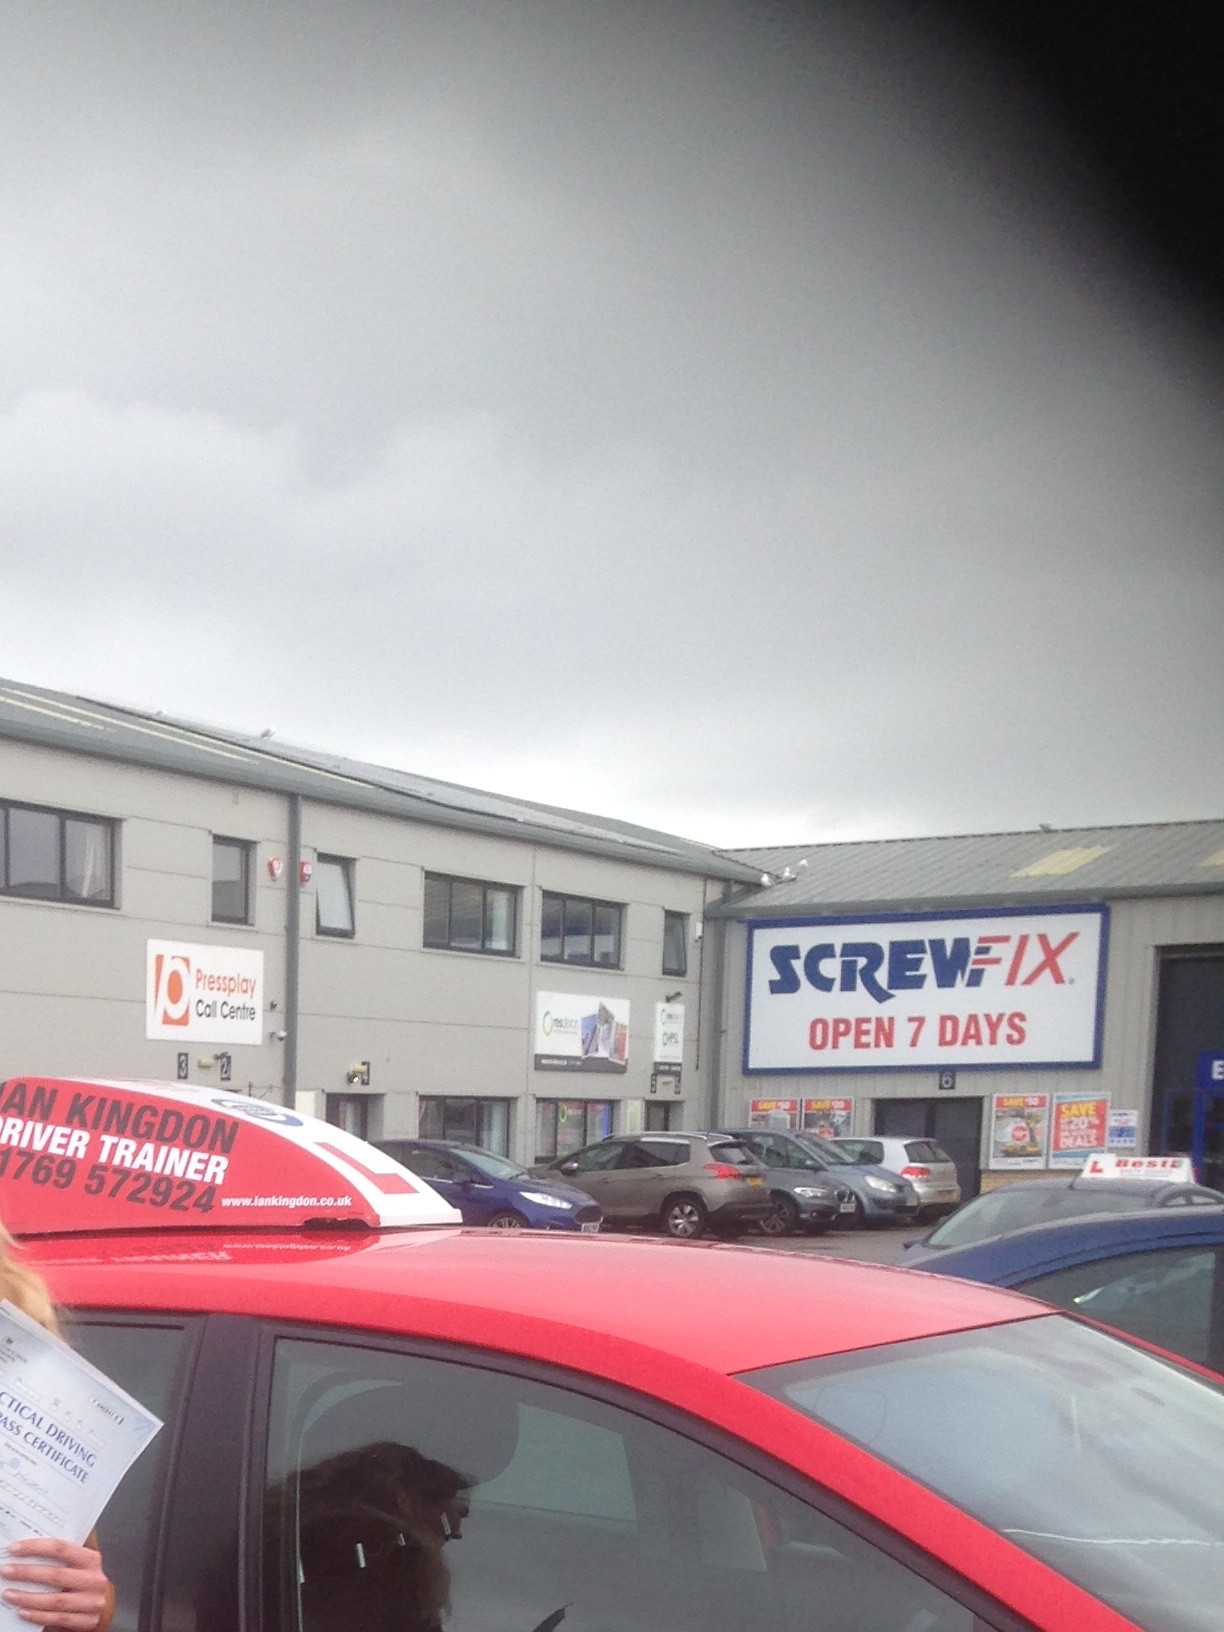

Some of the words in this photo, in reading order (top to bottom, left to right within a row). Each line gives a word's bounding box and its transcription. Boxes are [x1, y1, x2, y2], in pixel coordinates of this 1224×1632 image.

[195, 968, 256, 999] Pressplay
[768, 932, 1080, 1004] SCREWFIX
[195, 999, 218, 1018] Call
[220, 1001, 256, 1021] Centre
[809, 1016, 895, 1050] OPEN
[907, 1016, 926, 1047] 7
[938, 1012, 1027, 1047] DAYS
[178, 1055, 187, 1077] 3
[941, 1074, 954, 1089] 6
[66, 1093, 240, 1153] KINGDON
[1060, 1103, 1097, 1118] SAVE
[99, 1135, 229, 1185] TRAINER
[84, 1165, 218, 1214] 572924
[23, 1431, 90, 1484] CERTIFICATE
[45, 1423, 98, 1468] DRIVING
